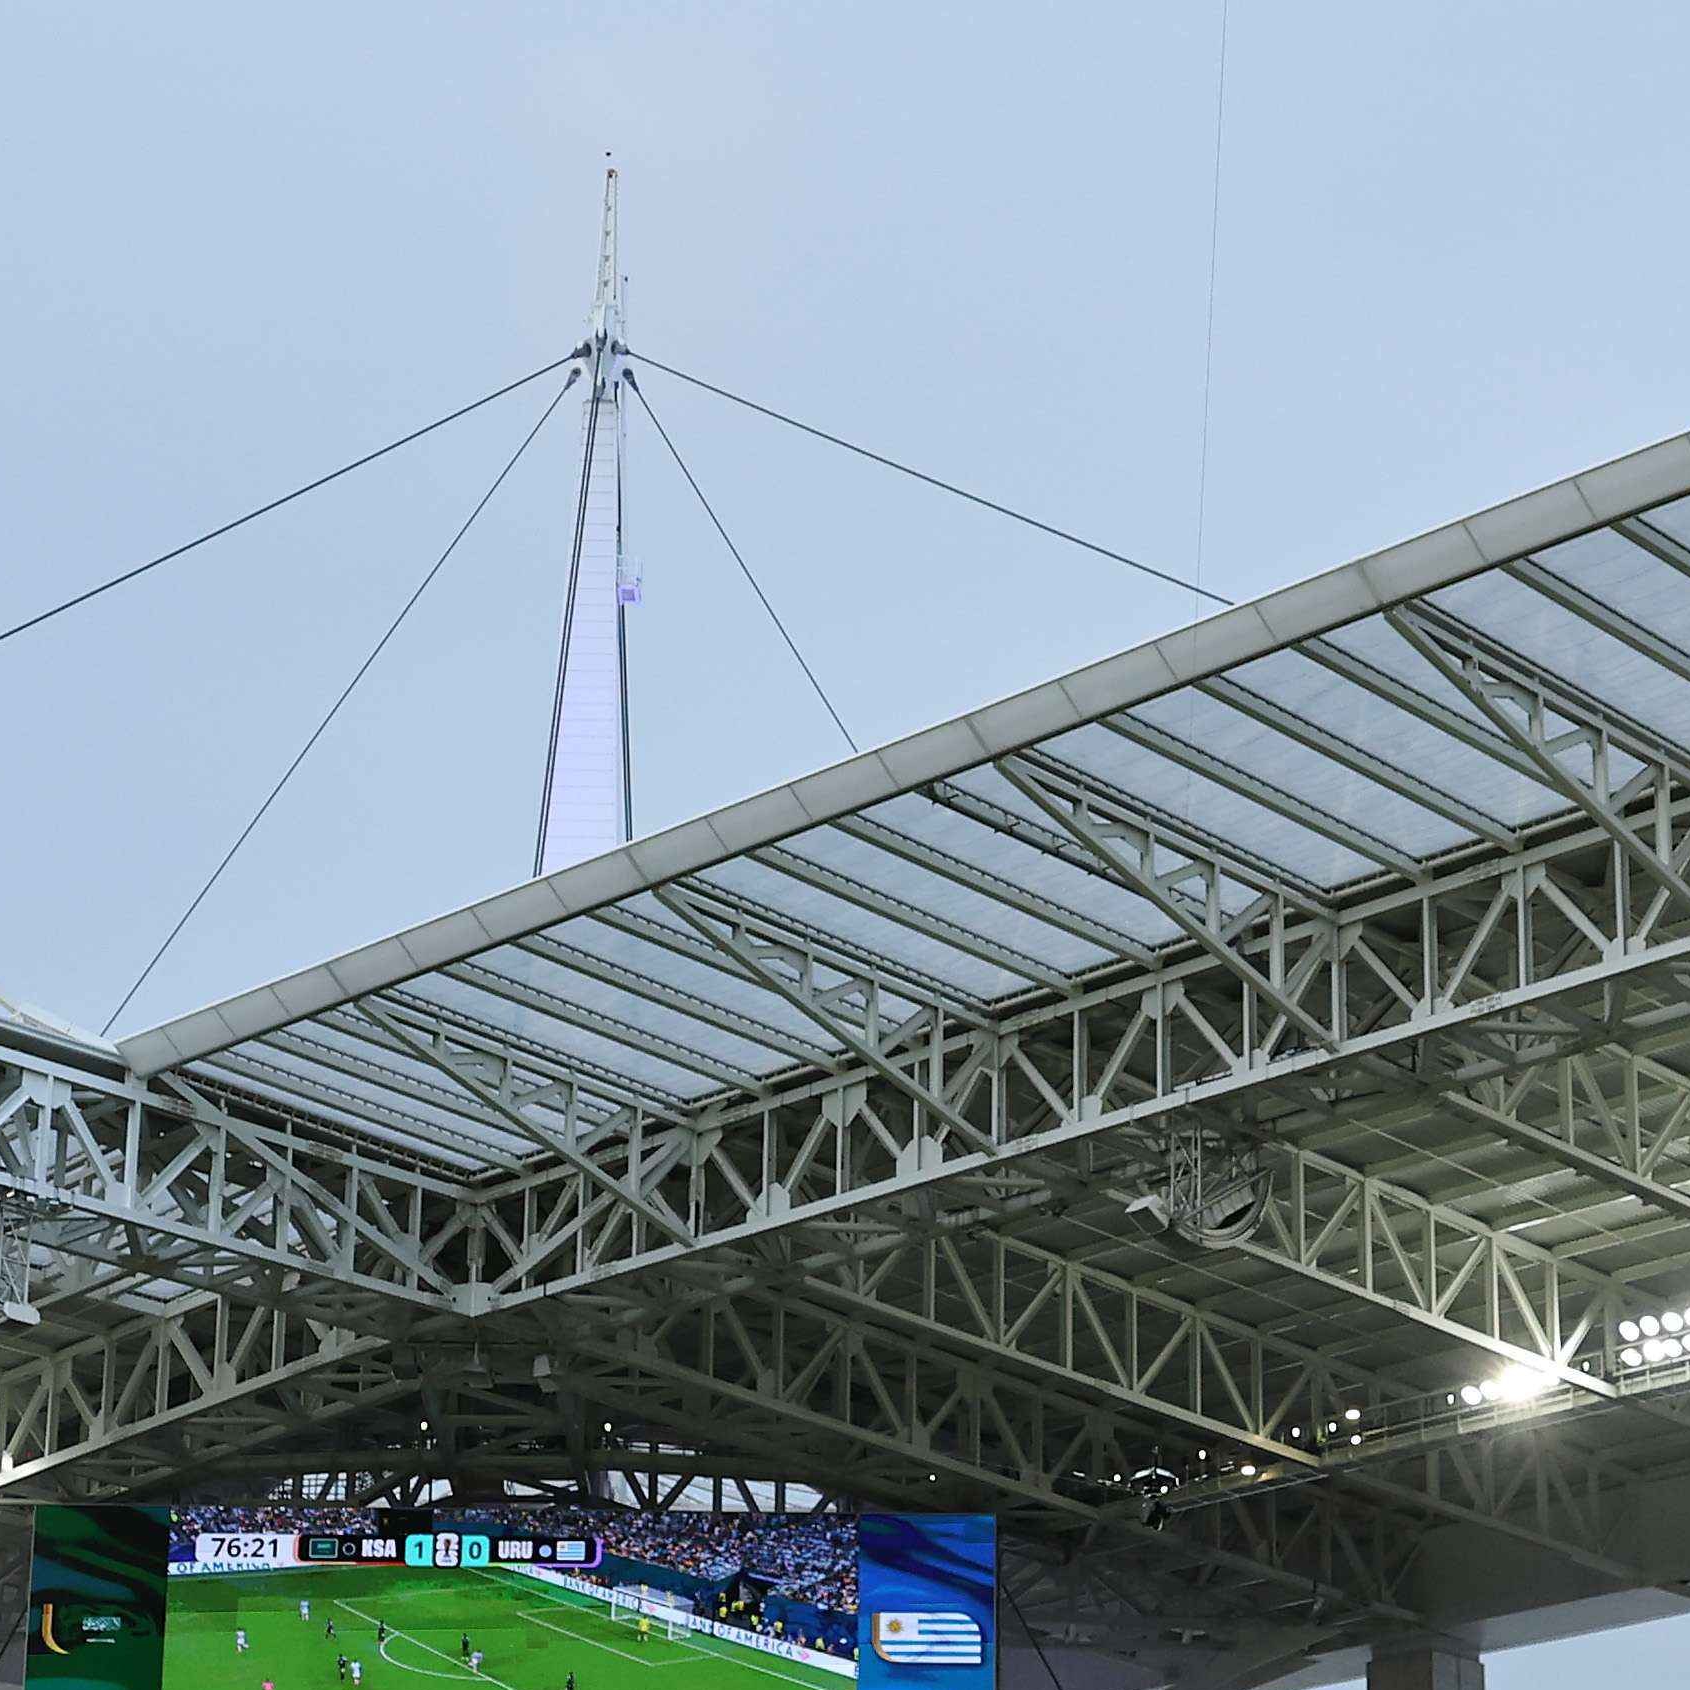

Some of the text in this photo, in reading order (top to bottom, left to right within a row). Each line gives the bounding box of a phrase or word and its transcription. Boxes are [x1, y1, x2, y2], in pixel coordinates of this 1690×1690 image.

[212, 1537, 279, 1558] 76:21
[361, 1539, 533, 1559] KSA 1 0 URU
